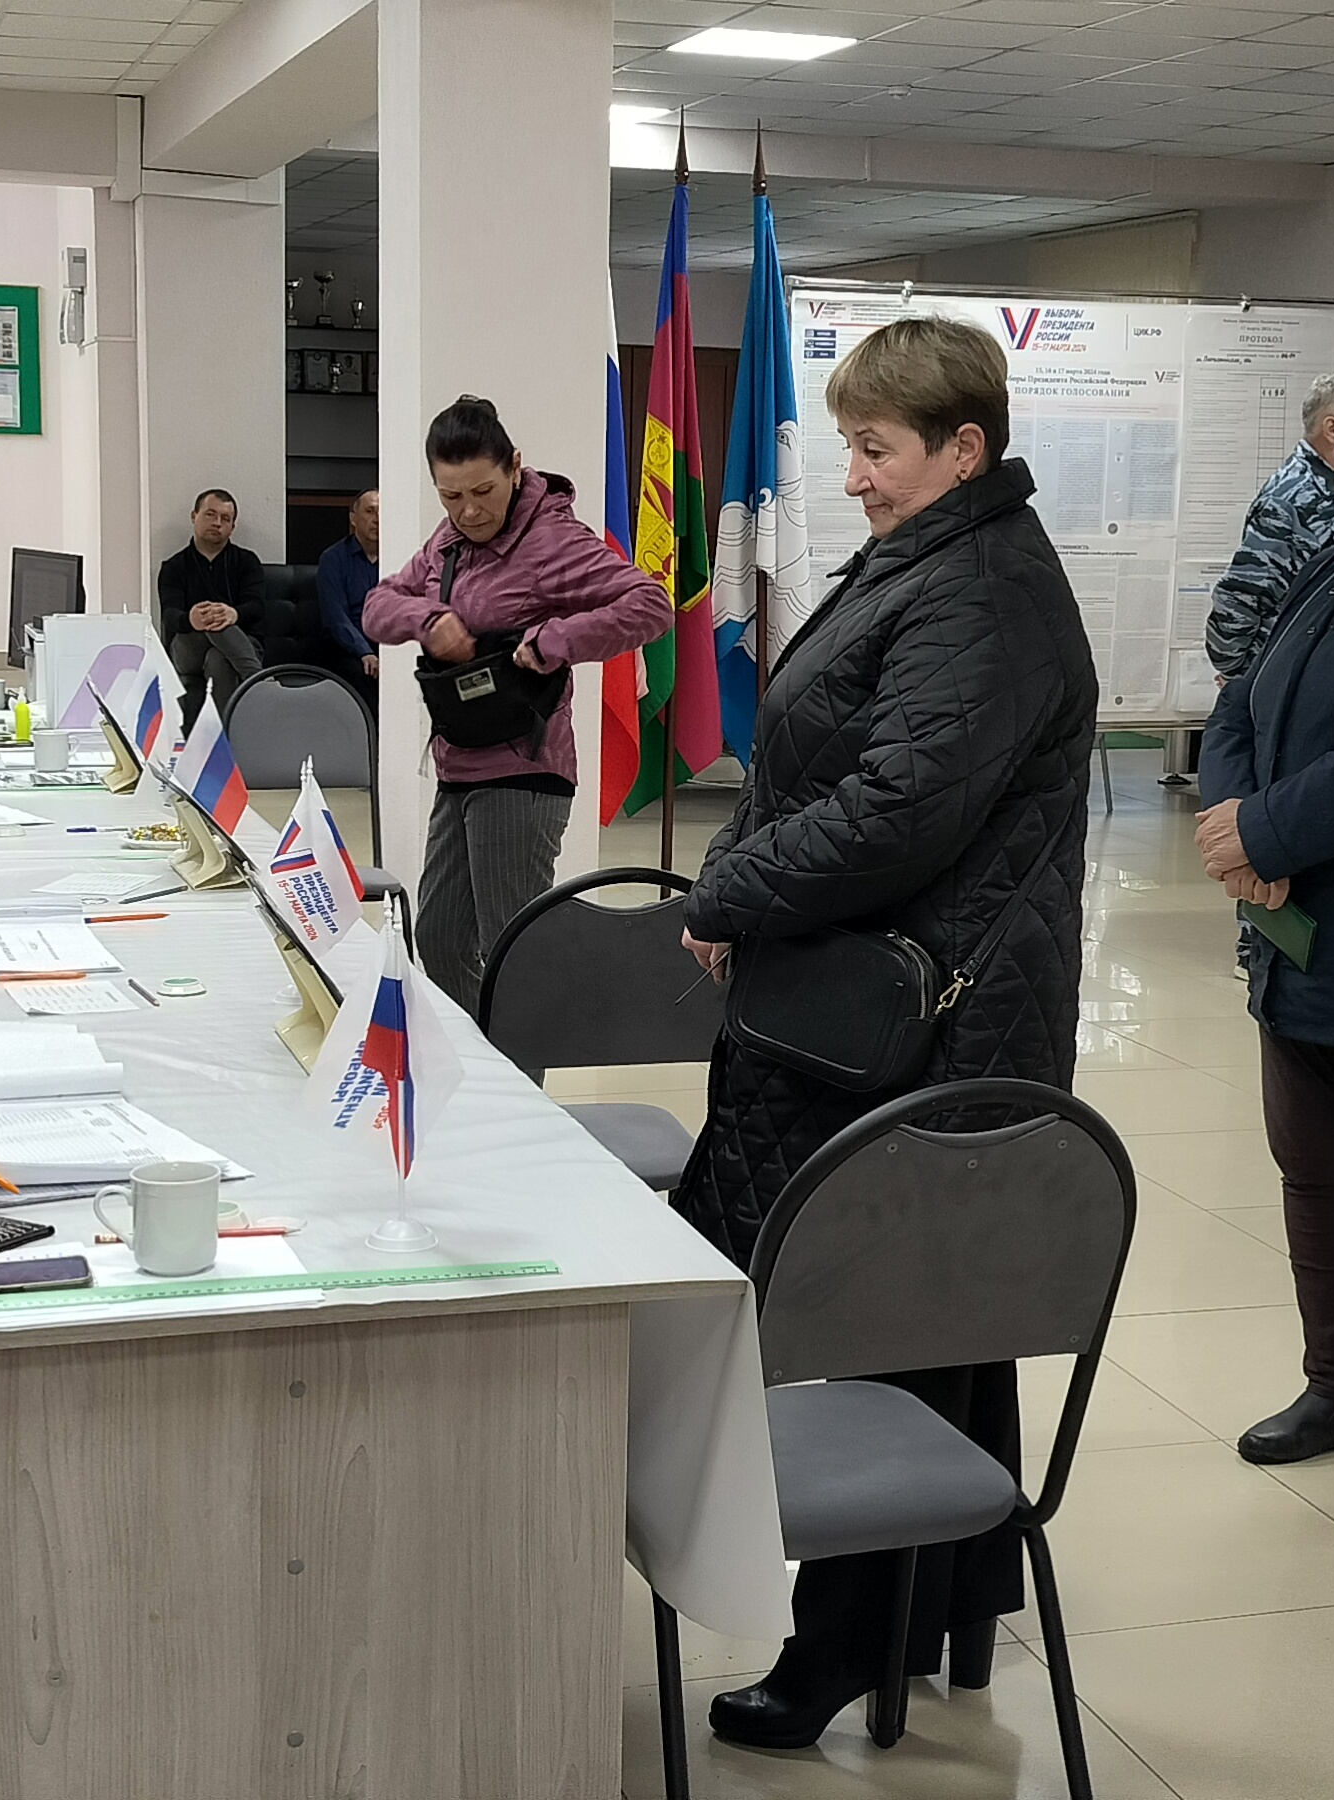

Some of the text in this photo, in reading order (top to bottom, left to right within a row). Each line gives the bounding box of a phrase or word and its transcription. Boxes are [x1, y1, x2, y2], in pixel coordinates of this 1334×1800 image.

[1044, 308, 1085, 319] ВЫБОРЫ
[1039, 320, 1095, 331] ПРЕЗИДЕНТА
[1034, 332, 1072, 342] РОССИИ
[1133, 327, 1162, 337] ЦИК.РФ
[1239, 335, 1284, 344] ПРОТОКОЛ
[1049, 343, 1071, 352] МАРТА
[1071, 344, 1087, 352] 2024
[1028, 375, 1068, 385] Президента
[1069, 376, 1108, 385] Российской
[1014, 387, 1131, 397] ПОРЯДОК ГОЛОСОВАНИЯ
[288, 876, 317, 916] РОССИИ
[313, 870, 339, 914] ВЫБОРЫ
[302, 873, 340, 935] ПРЕЗИДЕНТА
[288, 899, 309, 923] МАРТА
[303, 923, 319, 941] 2024
